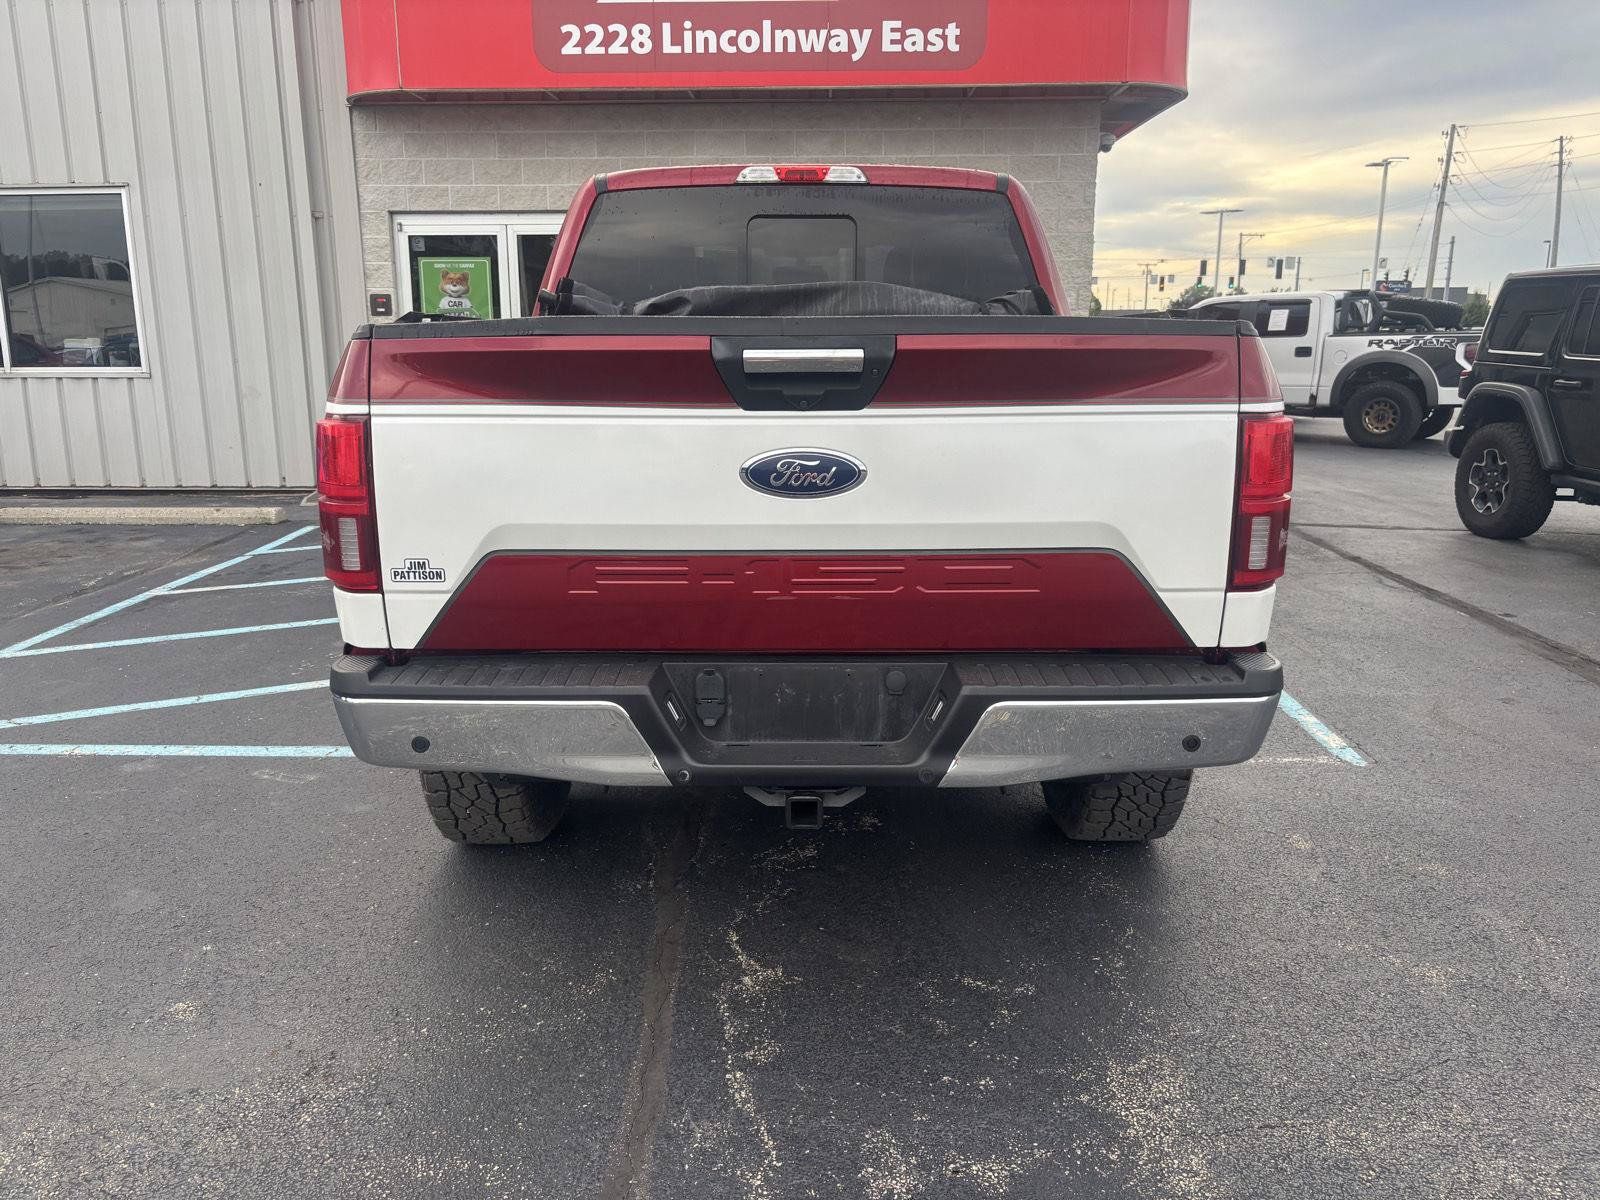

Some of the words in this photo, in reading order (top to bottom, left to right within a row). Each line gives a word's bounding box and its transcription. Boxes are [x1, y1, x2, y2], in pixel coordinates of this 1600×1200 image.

[560, 23, 652, 55] 2228
[662, 20, 872, 62] Lincolnway
[881, 20, 961, 52] East
[447, 300, 463, 308] CAR
[1367, 338, 1457, 351] RAPTOR
[769, 459, 837, 487] Ford
[407, 561, 427, 571] JIM
[393, 571, 443, 580] PATTISON
